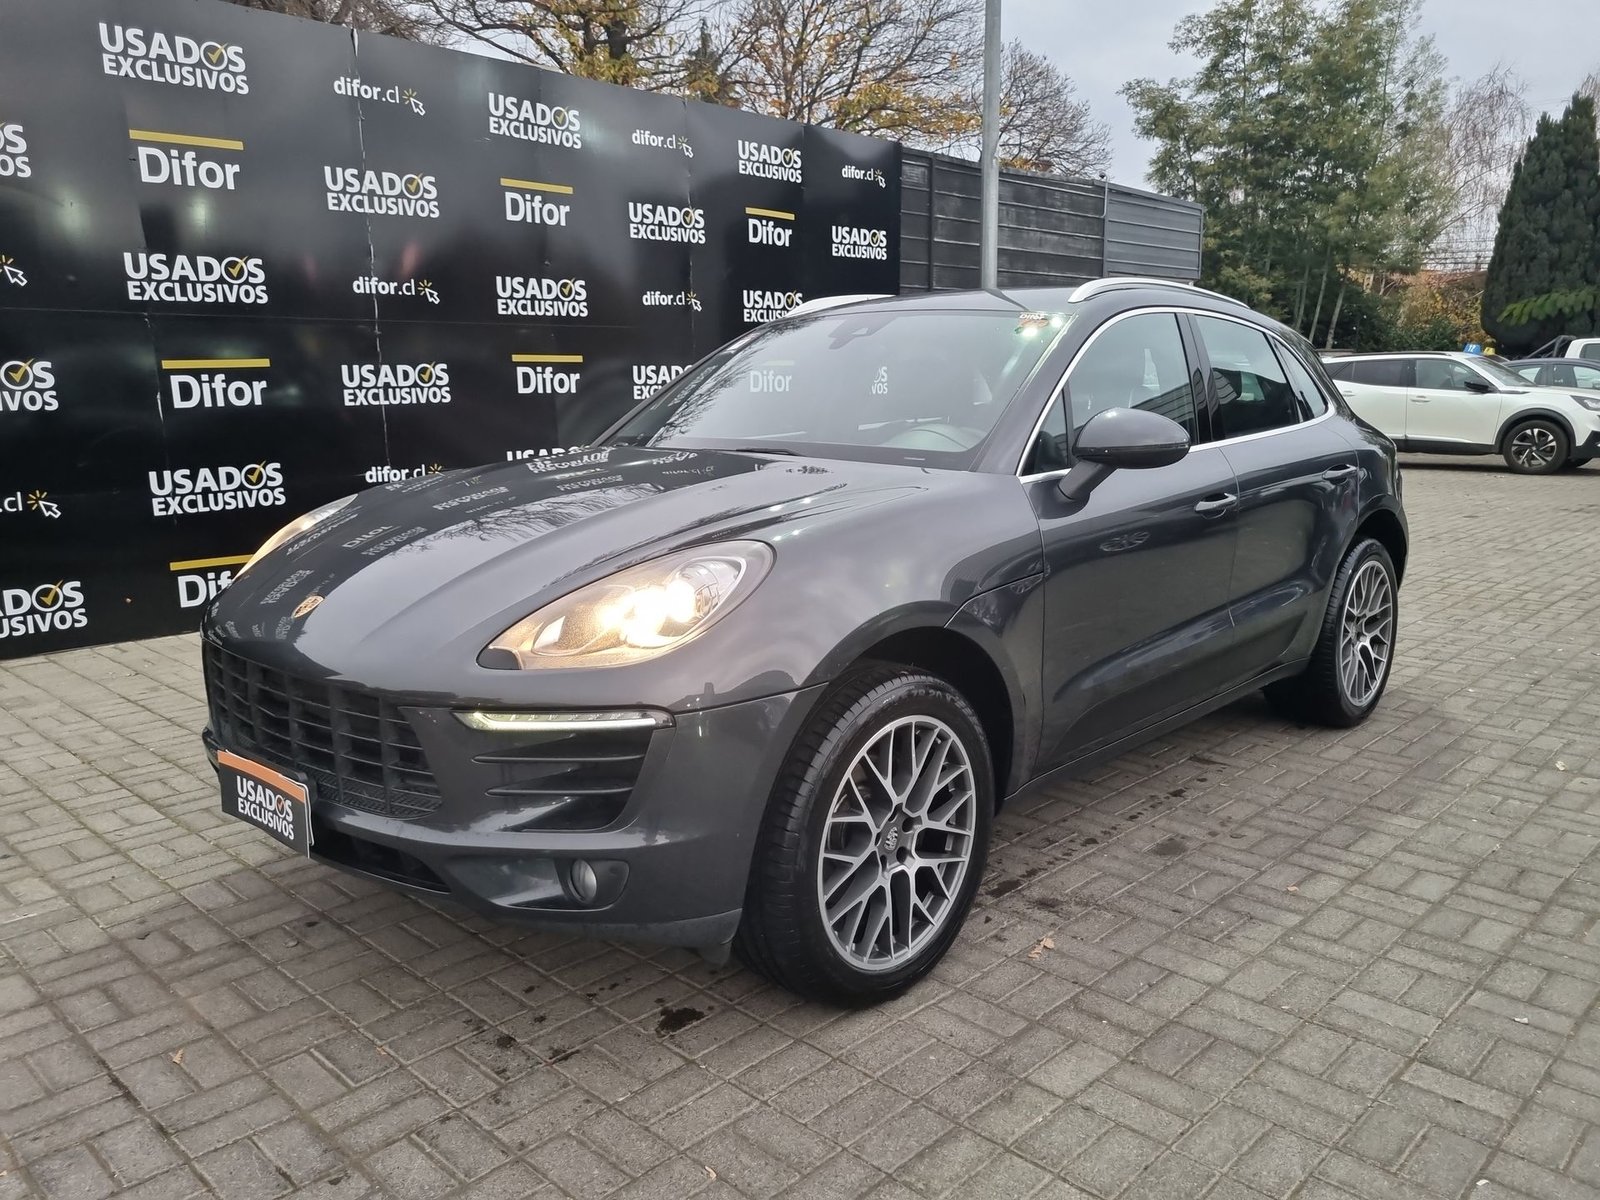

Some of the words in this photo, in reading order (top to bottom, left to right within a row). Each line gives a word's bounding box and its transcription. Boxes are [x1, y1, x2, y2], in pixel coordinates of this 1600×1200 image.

[98, 23, 246, 73] USADOS
[102, 54, 249, 95] EXCLUSIVOS
[333, 76, 400, 104] difor.cl
[488, 92, 581, 132] USADOS
[0, 124, 27, 153] S
[489, 117, 582, 149] EXCLUSIVOS
[631, 129, 677, 149] difor.cl
[137, 146, 240, 190] Difor
[737, 139, 802, 169] USADOS
[324, 166, 438, 200] USADOS
[738, 160, 802, 183] EXCLUSIVOS
[841, 165, 874, 181] difor.cl
[326, 192, 440, 218] EXCLUSIVOS
[505, 191, 570, 227] Difor
[628, 201, 705, 228] USADOS
[629, 224, 706, 244] EXCLUSIVOS
[748, 218, 793, 247] Difor
[831, 225, 887, 248] USADOS
[832, 243, 887, 260] EXCLUSIVOS
[123, 252, 266, 284] USADOS
[127, 280, 269, 304] EXCLUSIVOS
[352, 276, 416, 296] difor.cl
[495, 275, 587, 302] USADOS
[642, 291, 685, 306] difor.cl
[743, 290, 803, 310] USADOS
[497, 299, 589, 317] EXCLUSIVOS
[743, 309, 789, 322] EXCLUSI
[341, 362, 449, 388] USADOS
[516, 366, 581, 394] Difor
[748, 370, 792, 393] Difor
[170, 373, 267, 409] Difor
[343, 387, 452, 406] EXCLUSIVOS
[148, 462, 283, 496] USADOS
[151, 487, 286, 517] EXCLUSIVOS
[0, 580, 84, 617] DOS
[177, 570, 232, 608] Dif
[236, 775, 293, 822] USADOS
[237, 797, 295, 840] EXCLUSIVOS
